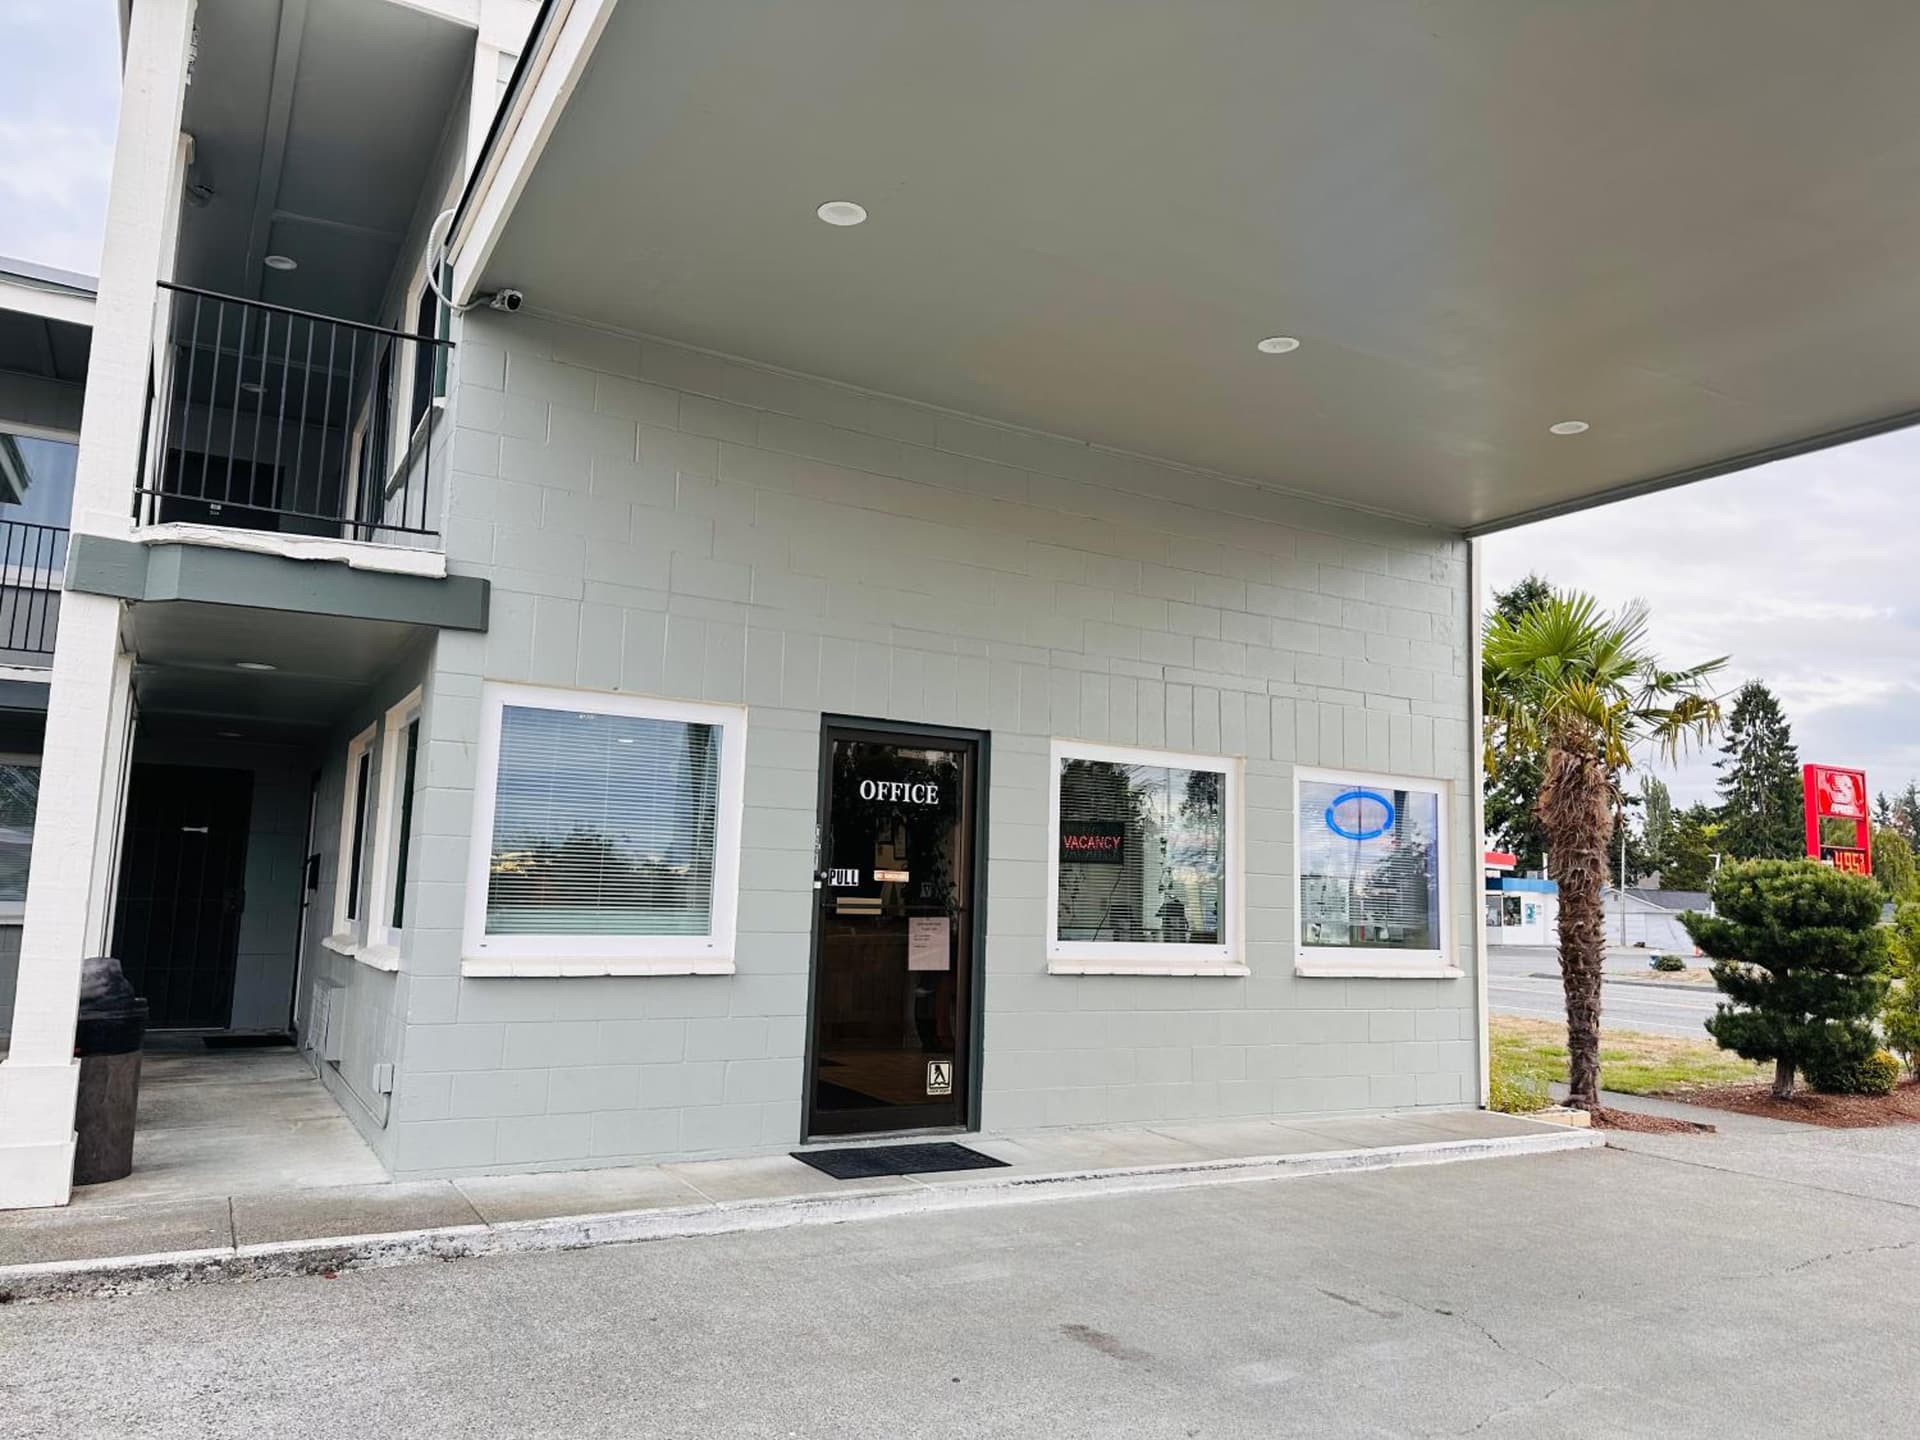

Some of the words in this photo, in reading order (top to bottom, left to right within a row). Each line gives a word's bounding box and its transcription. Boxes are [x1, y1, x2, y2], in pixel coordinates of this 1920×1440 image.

[860, 780, 939, 804] OFFICE
[1063, 835, 1120, 849] VACANCY
[829, 869, 858, 885] PULL
